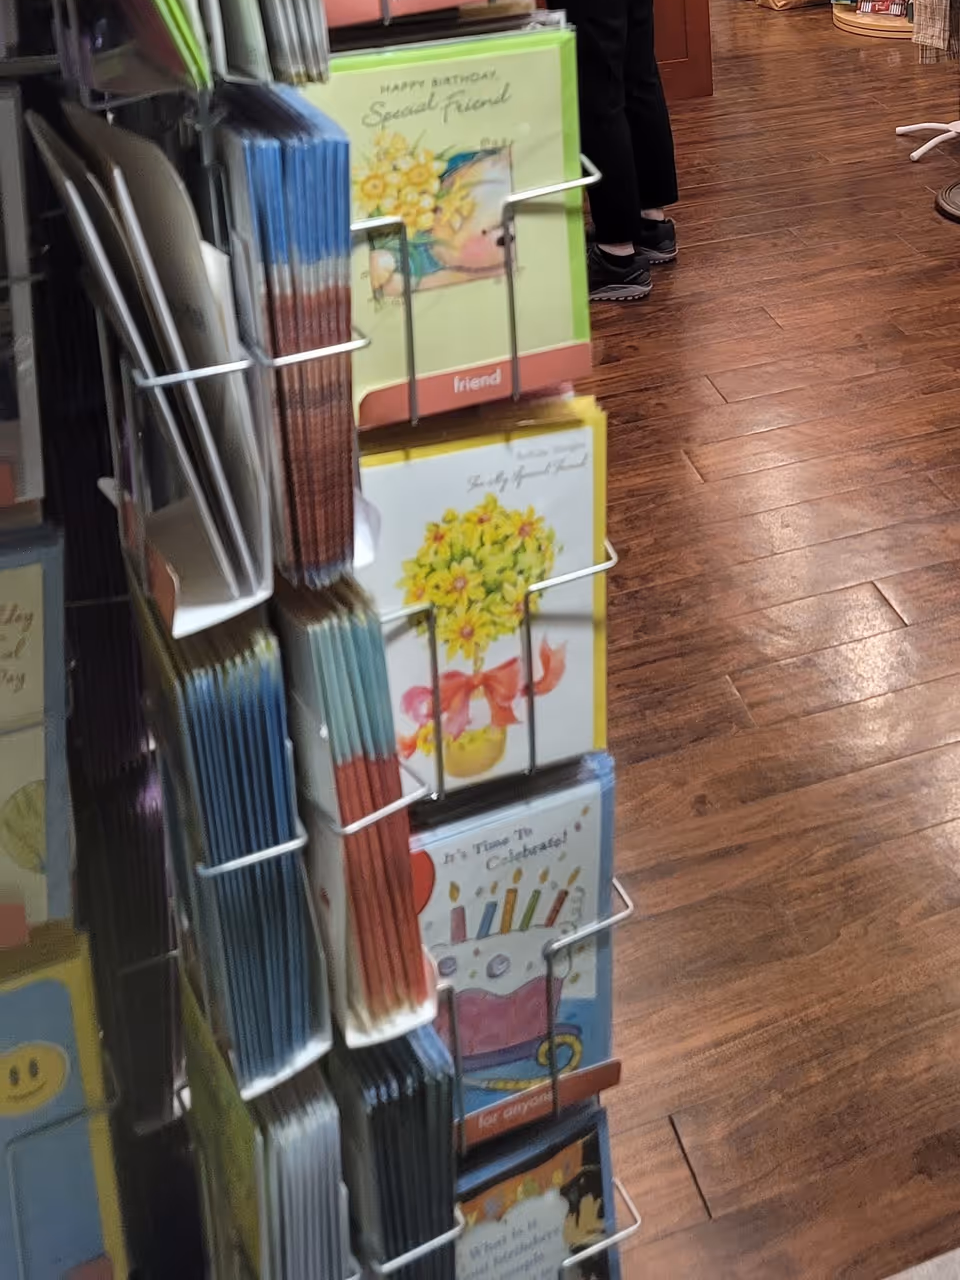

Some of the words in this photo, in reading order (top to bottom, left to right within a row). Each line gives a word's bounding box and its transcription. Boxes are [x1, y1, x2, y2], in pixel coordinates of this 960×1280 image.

[380, 79, 425, 95] HAPPY
[361, 92, 438, 131] Special
[441, 81, 512, 124] Friend
[453, 368, 501, 395] friend
[443, 849, 467, 865] It's
[473, 837, 510, 855] Time
[514, 827, 533, 841] To
[486, 828, 568, 871] Celebrate!
[478, 1113, 500, 1129] for
